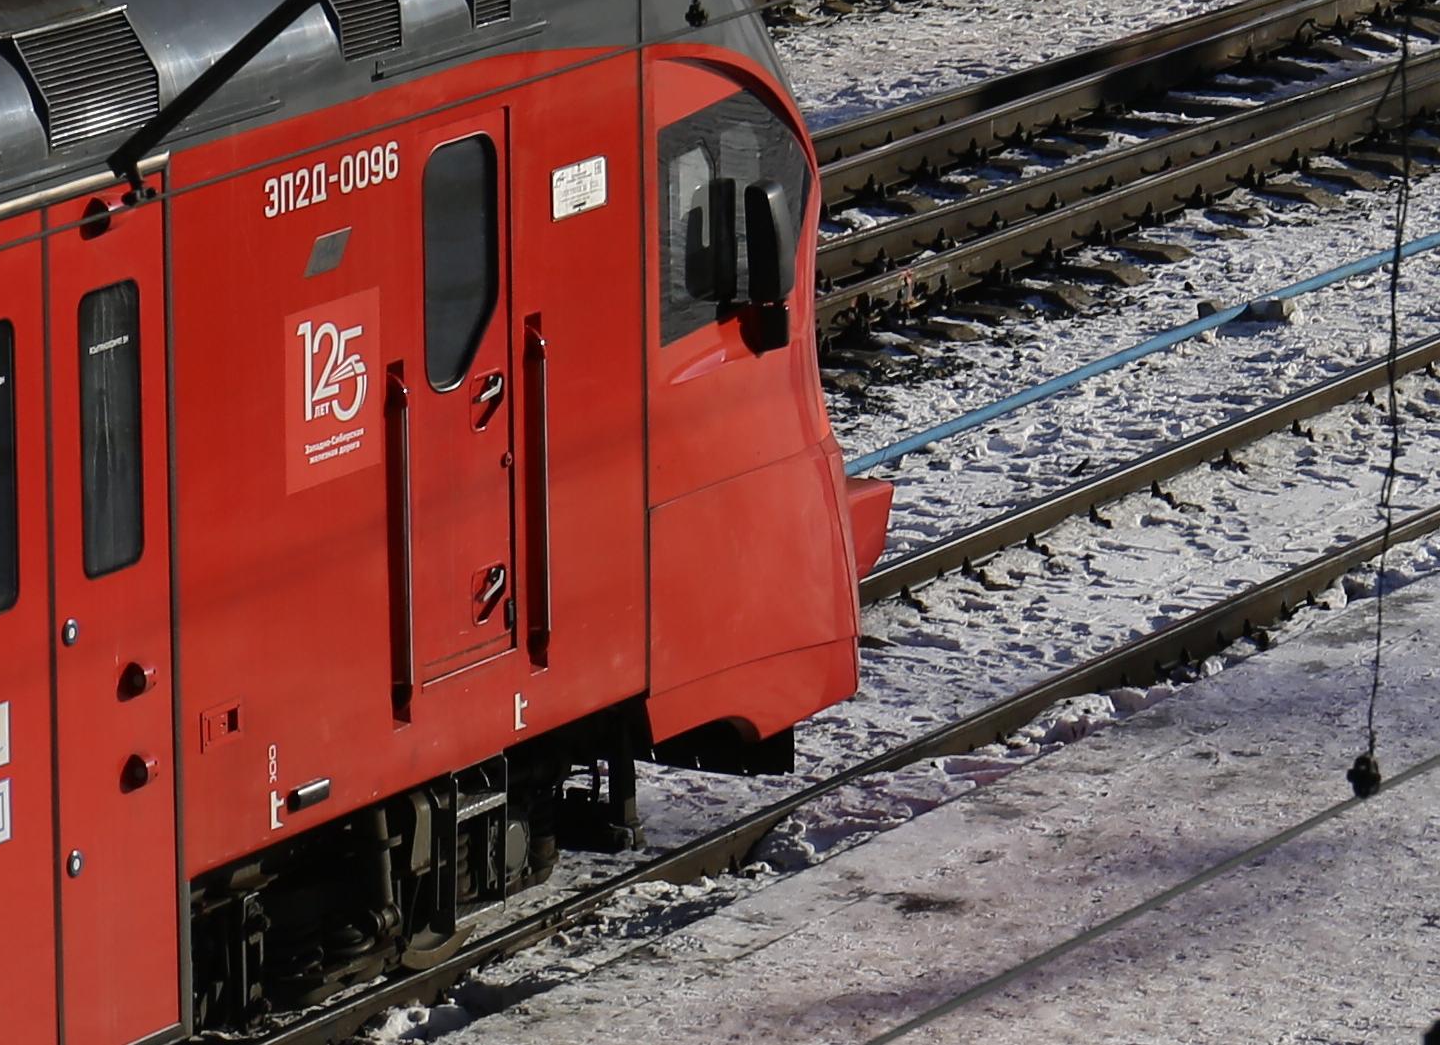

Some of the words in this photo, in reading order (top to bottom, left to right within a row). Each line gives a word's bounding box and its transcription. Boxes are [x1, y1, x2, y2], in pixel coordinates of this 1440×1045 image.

[264, 140, 399, 219] ЭП2Д-0096
[296, 320, 368, 422] 125
[313, 401, 330, 419] ЛЕТ
